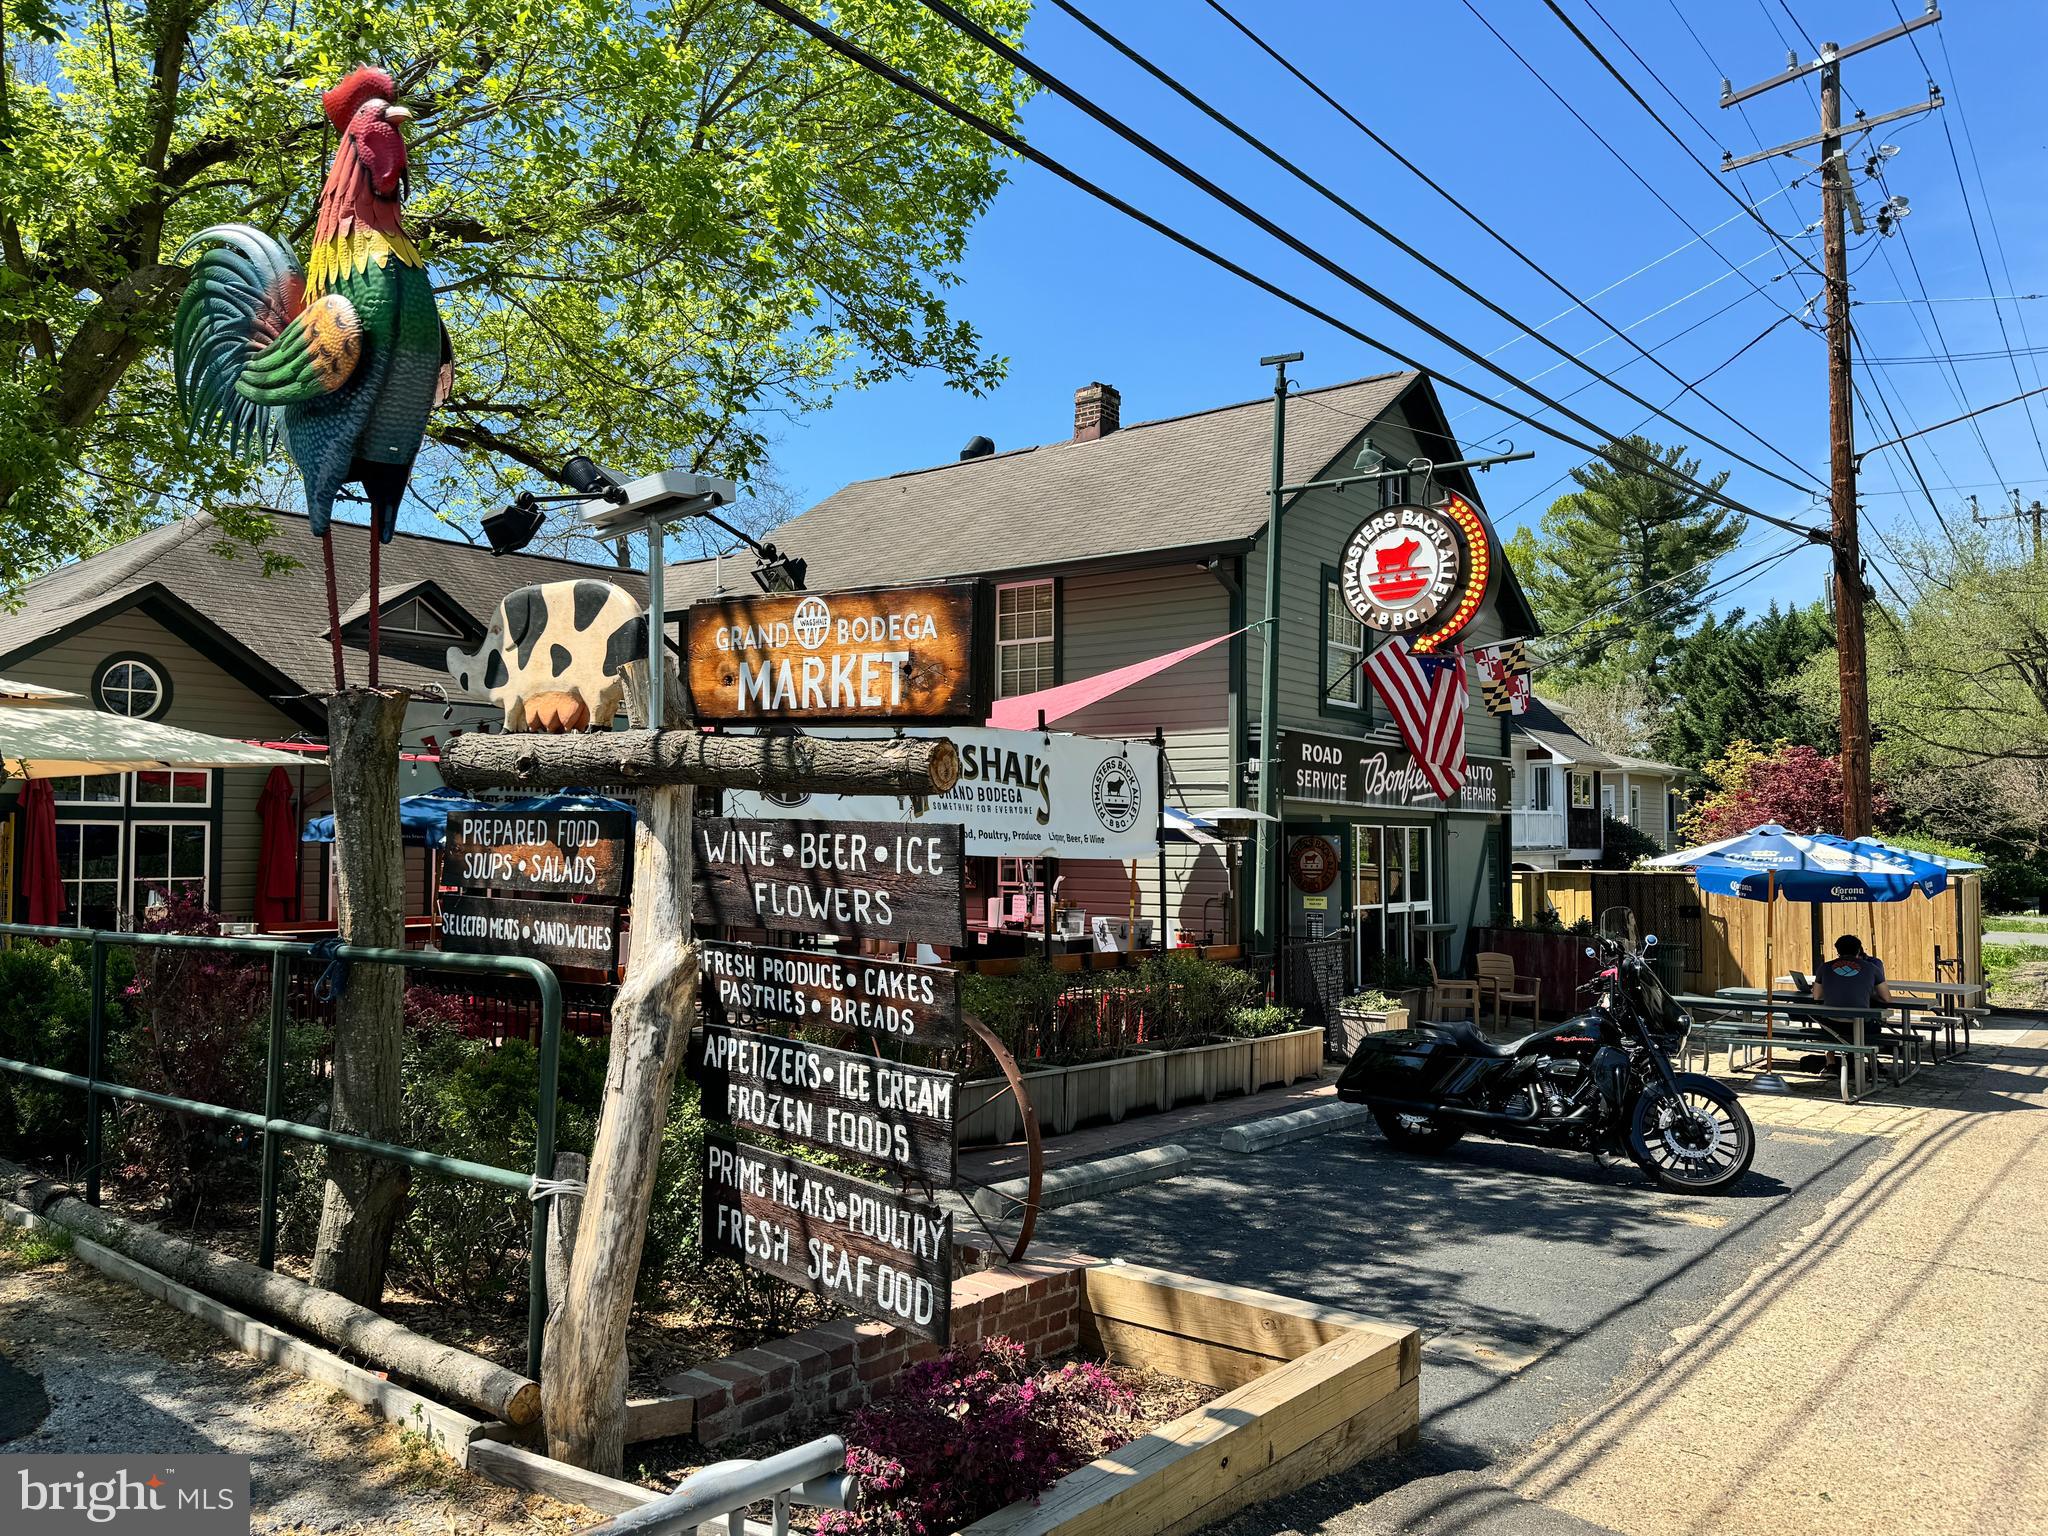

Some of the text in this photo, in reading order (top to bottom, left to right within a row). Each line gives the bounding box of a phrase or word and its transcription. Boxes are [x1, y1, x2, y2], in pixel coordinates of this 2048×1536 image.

[1344, 510, 1457, 616] PITMASTERS BACK ALLEY
[716, 614, 938, 651] GRAND BODEGA
[1378, 609, 1419, 626] BBQ
[738, 652, 909, 711] MARKET
[1302, 744, 1492, 782] ROAD AUTO
[978, 787, 1023, 803] BODEGA
[1094, 760, 1138, 820] PITMASTERS BACK ALLEY
[1296, 769, 1496, 802] SERVICE REPAIRS
[933, 802, 1032, 814] SOMETHING FOR EVERYONE
[1109, 819, 1126, 828] BBQ
[462, 819, 600, 847] PREPARED FOOD
[979, 830, 1010, 842] Poultry,
[1012, 830, 1041, 840] Produce
[1066, 834, 1082, 844] Beer,
[1084, 834, 1088, 843] &
[1090, 834, 1104, 844] Wine
[463, 853, 596, 884] SOUPS SALADS
[704, 830, 944, 876] WINE BEER ICE
[754, 882, 892, 926] FLOWERS
[1830, 886, 1864, 896] Corona
[442, 912, 611, 950] SELECTED MEATS SANDWICHES
[704, 950, 934, 1004] FRESH PRODUCE CAKES
[720, 980, 914, 1035] PASTRIES BREADS
[704, 1034, 951, 1120] APPETIZERS ICE CREAM
[728, 1084, 910, 1163] FROZEN FOODS
[709, 1146, 946, 1262] PRIME MEATS POULTRY
[718, 1204, 934, 1325] FRESH SEAFOOD
